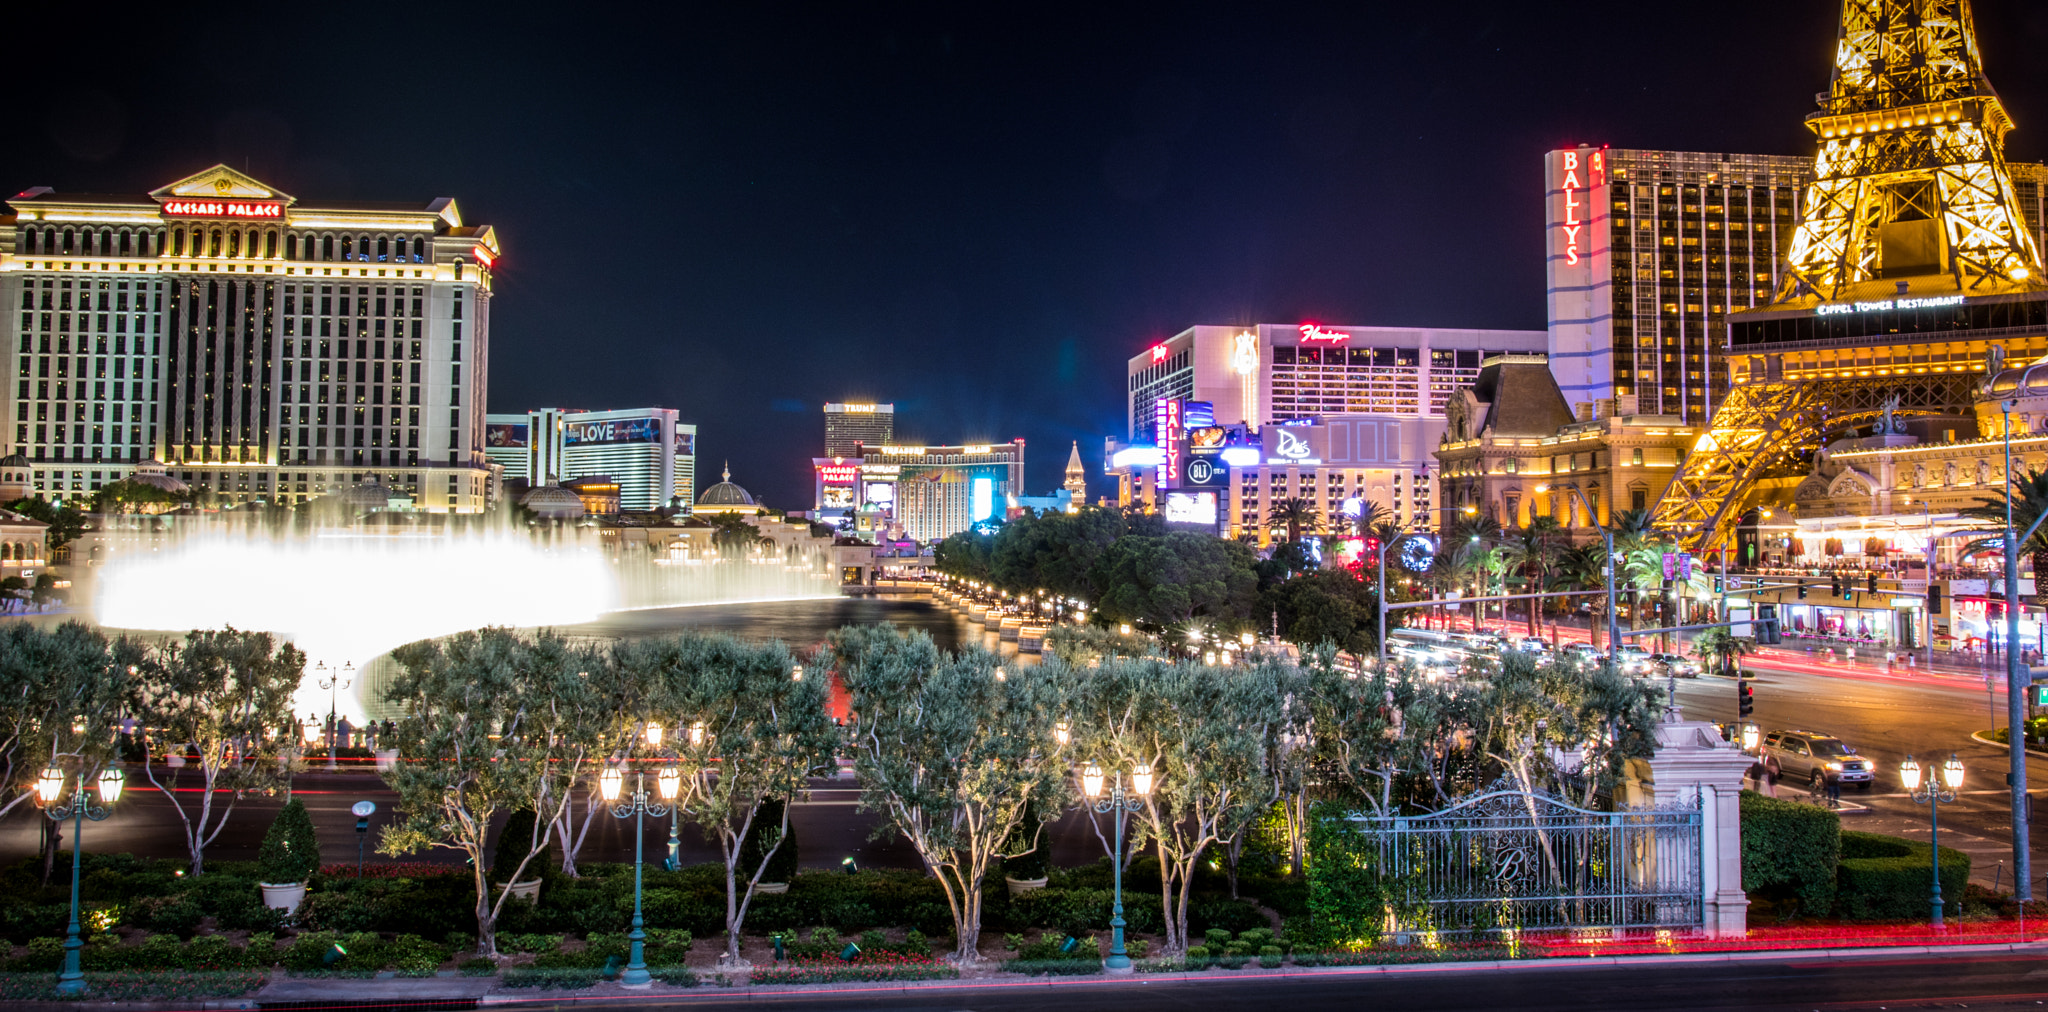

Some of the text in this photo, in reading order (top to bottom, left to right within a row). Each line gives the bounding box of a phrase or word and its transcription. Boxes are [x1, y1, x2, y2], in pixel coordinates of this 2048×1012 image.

[164, 202, 280, 217] CAESARS PALACE
[1562, 151, 1581, 266] BALLYS
[1817, 295, 1965, 315] EIFFEL TOWER RESTAURANT
[1299, 324, 1350, 344] Flamingo
[844, 404, 876, 412] TRUMP
[580, 424, 615, 442] LOVE
[1167, 402, 1179, 479] BALLYS
[1193, 464, 1208, 479] BLT
